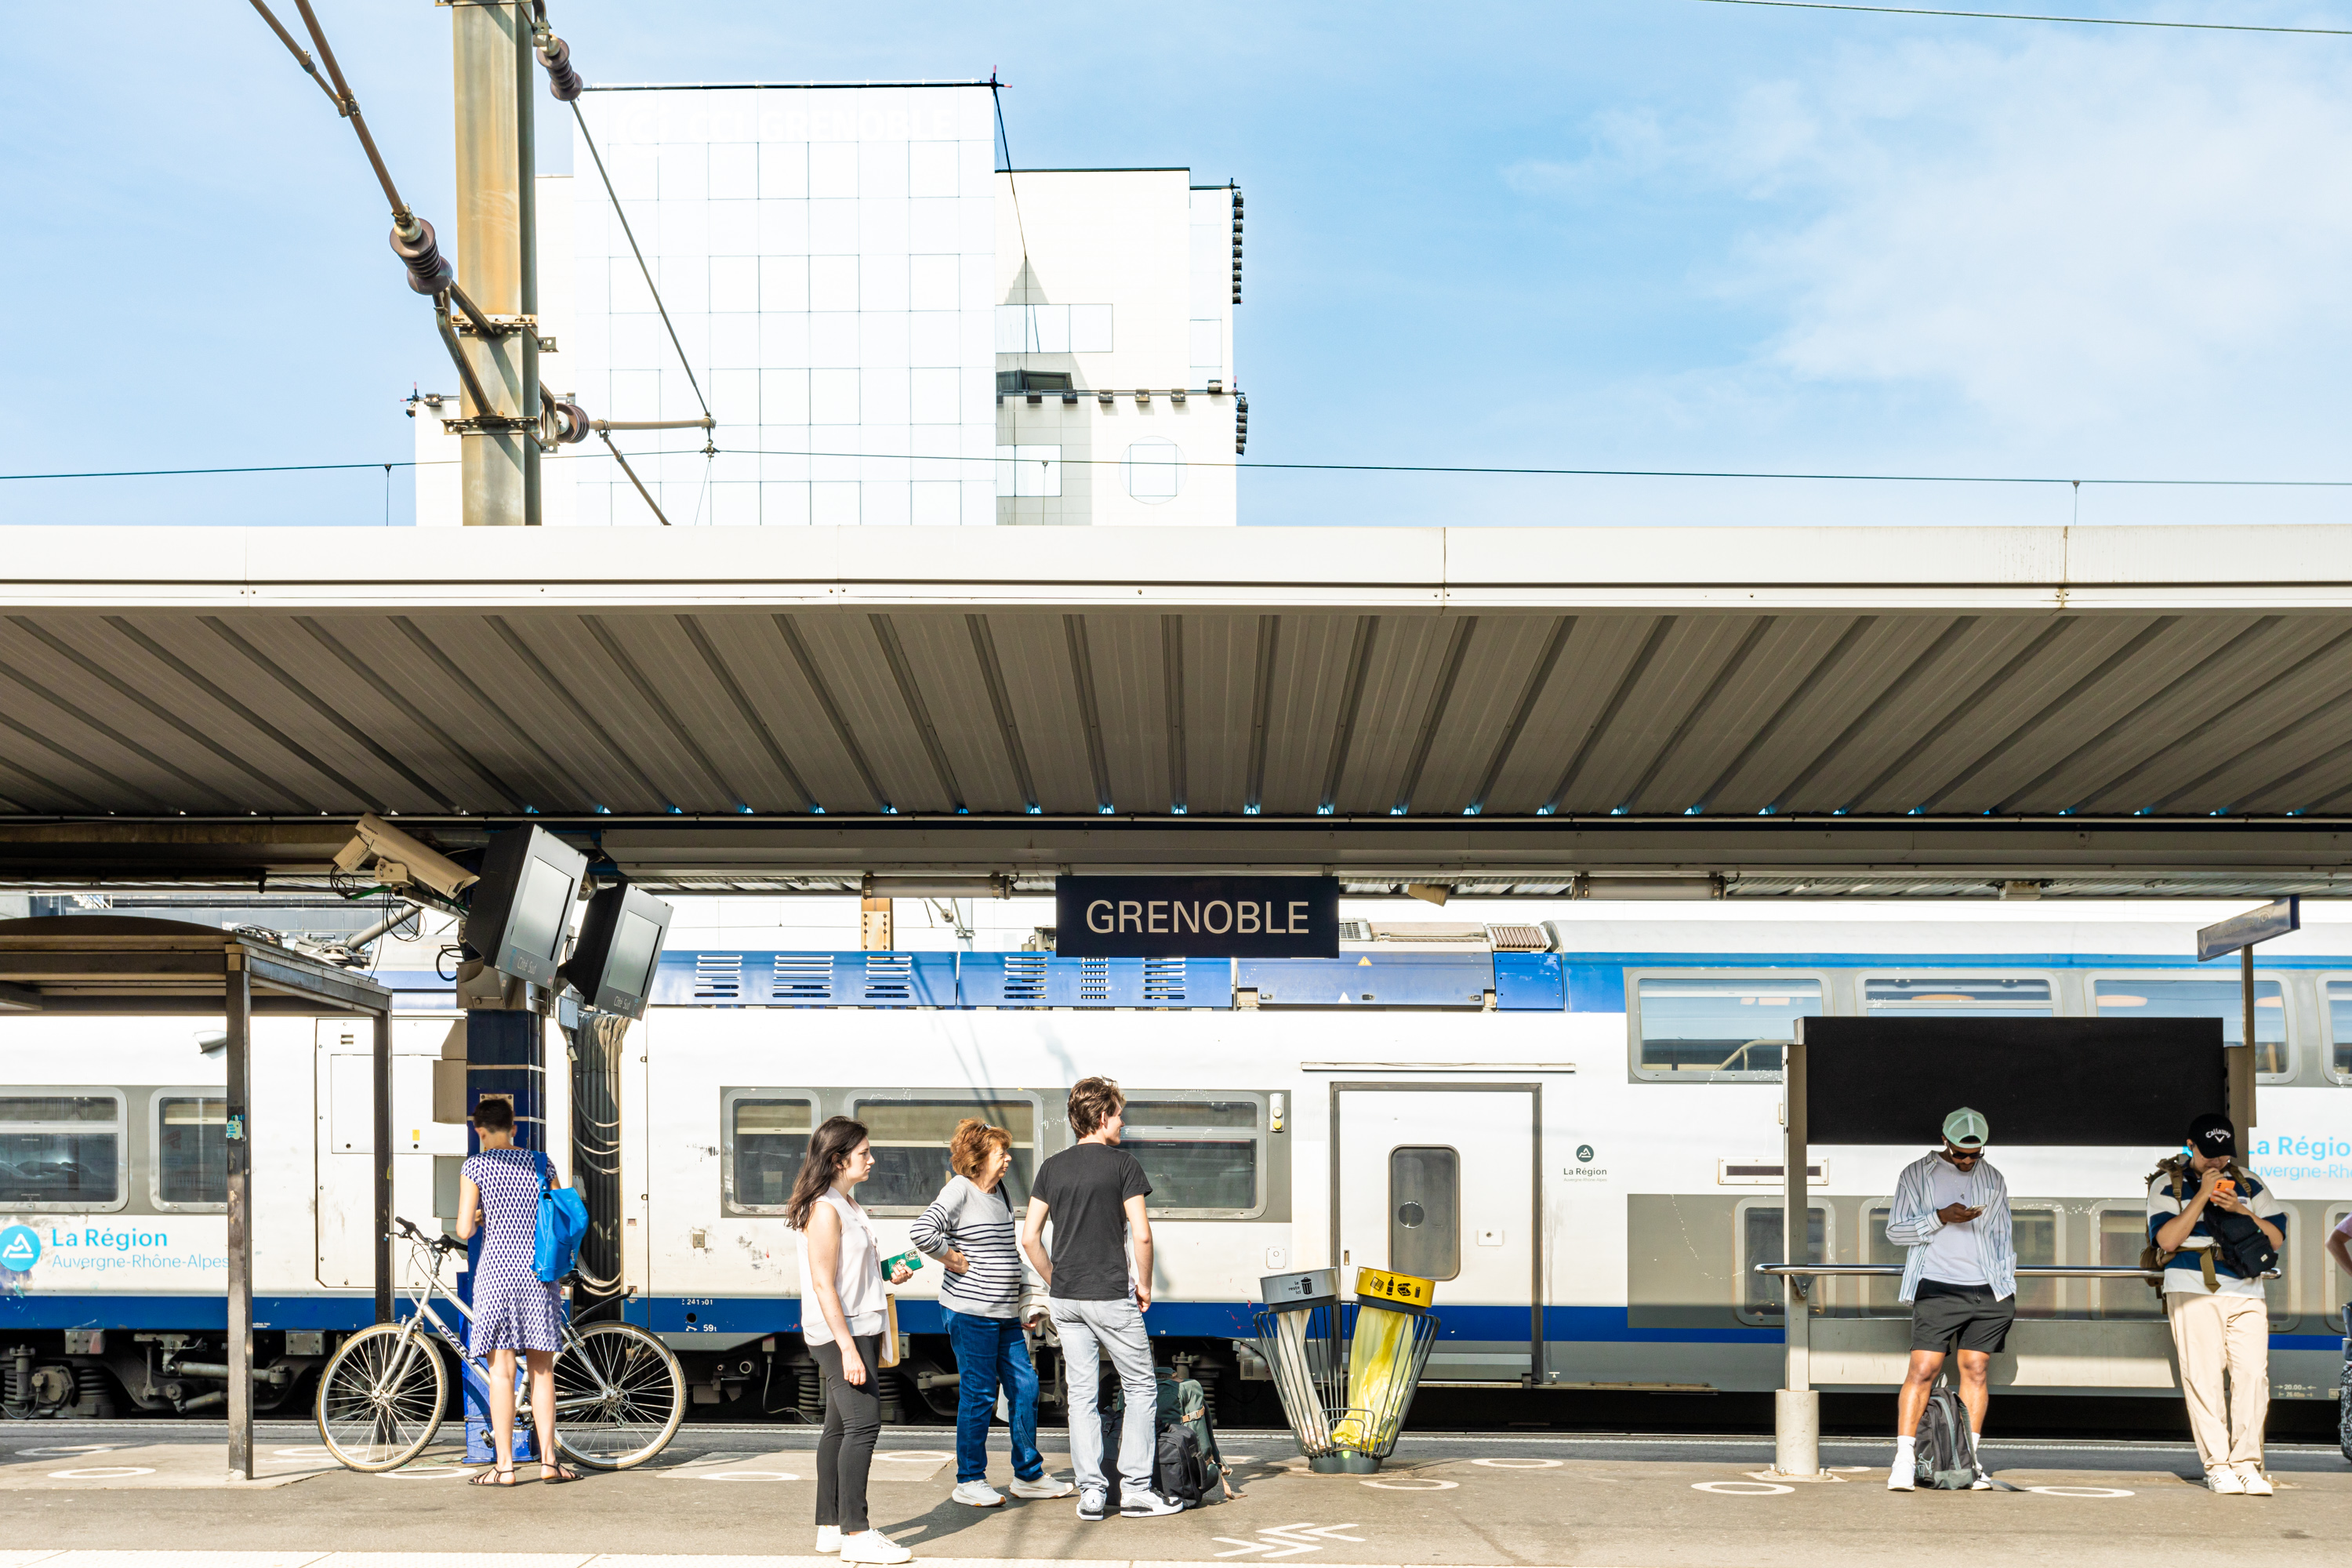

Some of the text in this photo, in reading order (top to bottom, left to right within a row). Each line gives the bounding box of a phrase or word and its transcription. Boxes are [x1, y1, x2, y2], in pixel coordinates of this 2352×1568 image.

[757, 107, 953, 143] GRENOBLE
[1086, 899, 1310, 935] GRENOBLE
[2205, 1127, 2232, 1139] Callaway
[2249, 1140, 2270, 1155] a
[1576, 1167, 1607, 1177] Région
[2249, 1163, 2352, 1181] uvergne-Rh
[52, 1227, 168, 1251] La Région
[52, 1254, 228, 1271] Auvergne-Rhône-Alpes
